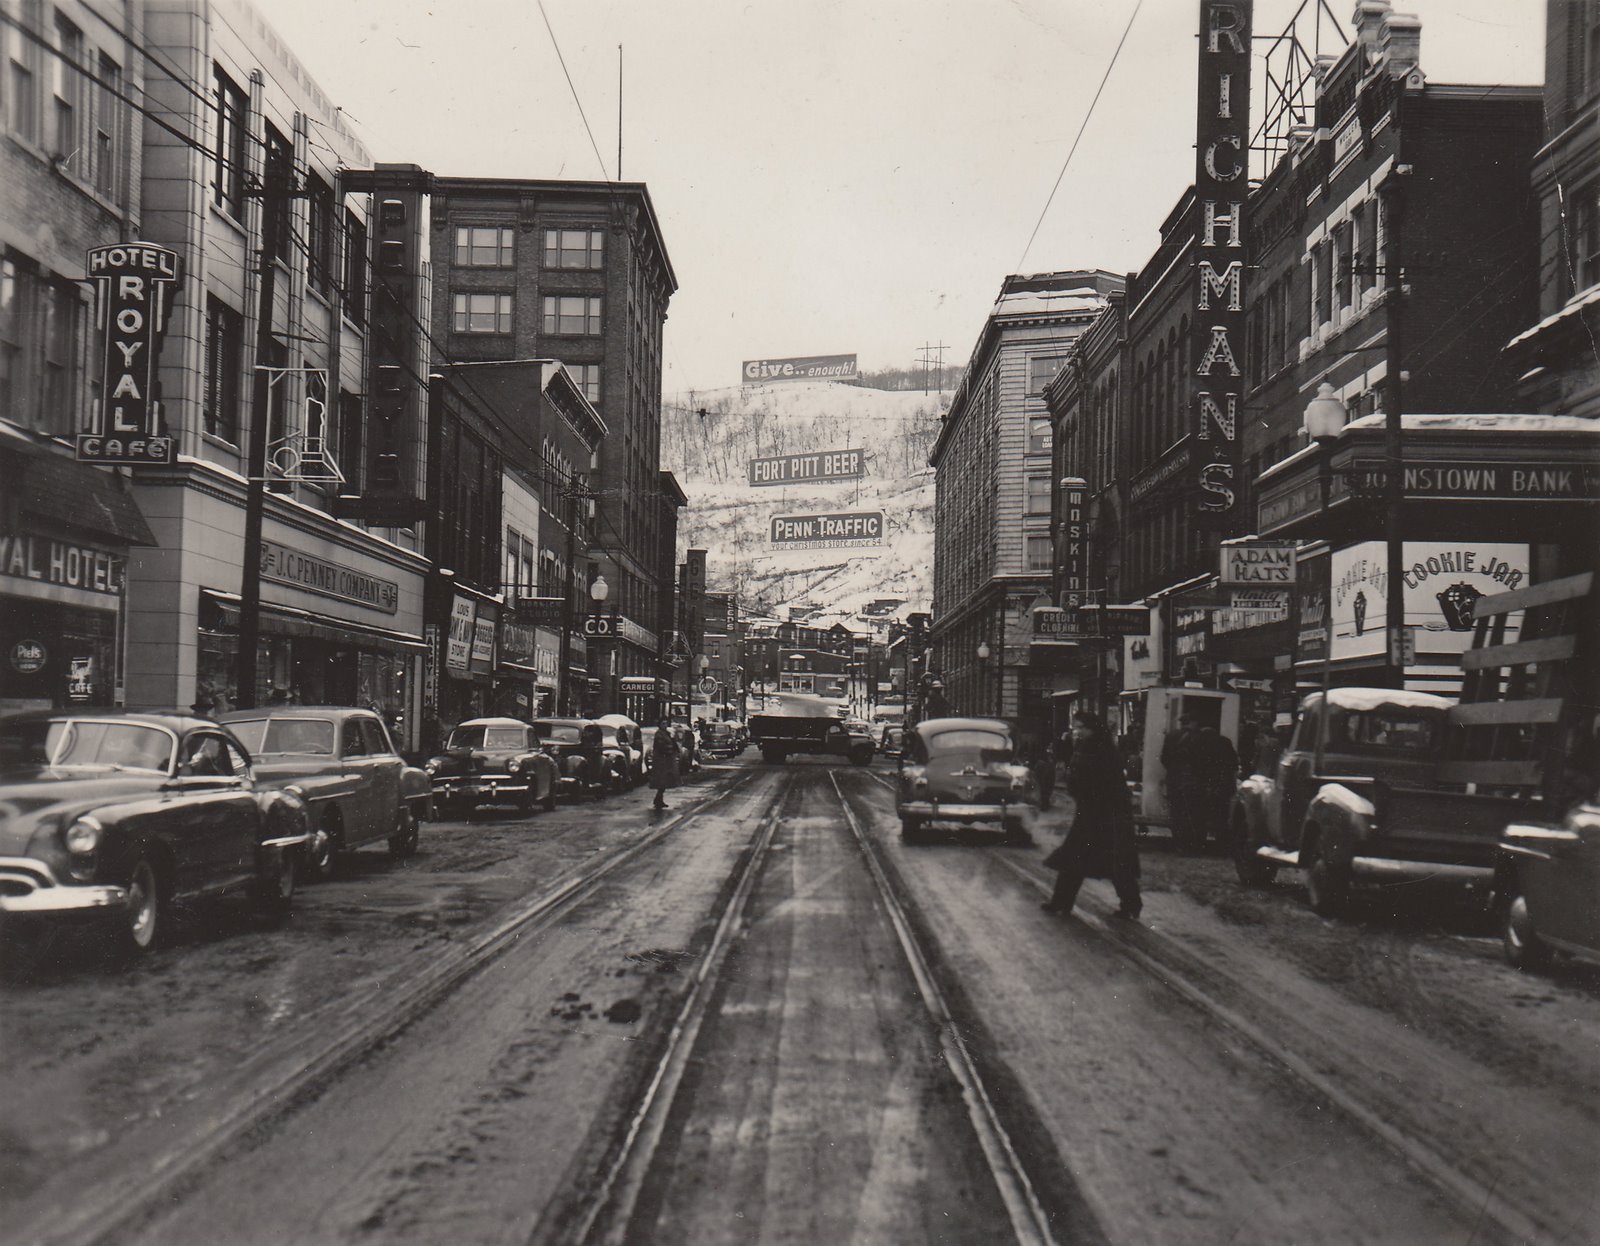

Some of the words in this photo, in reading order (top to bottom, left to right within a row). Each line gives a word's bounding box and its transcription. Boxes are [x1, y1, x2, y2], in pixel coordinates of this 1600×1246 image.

[91, 248, 173, 275] HOTEL
[1197, 4, 1246, 513] RICHMANS
[112, 276, 145, 432] ROYAL
[808, 361, 854, 377] enough!
[754, 460, 786, 481] FORT
[791, 457, 819, 478] PITT
[824, 453, 859, 475] BEER
[1365, 468, 1496, 491] JONSTOWN
[1511, 469, 1573, 492] BANK
[775, 519, 813, 539] PENN
[817, 517, 878, 537] TRAFFIC
[50, 542, 118, 592] HOTEL
[1231, 550, 1291, 567] ADAM
[1235, 564, 1289, 581] HATS
[1401, 551, 1477, 589] COOKIE
[1481, 557, 1524, 590] JAR
[339, 571, 382, 603] COMPANY
[585, 619, 612, 634] CO.
[1043, 613, 1077, 622] CREDIT
[69, 683, 93, 694] CAFE
[621, 683, 655, 691] CARNEGI
